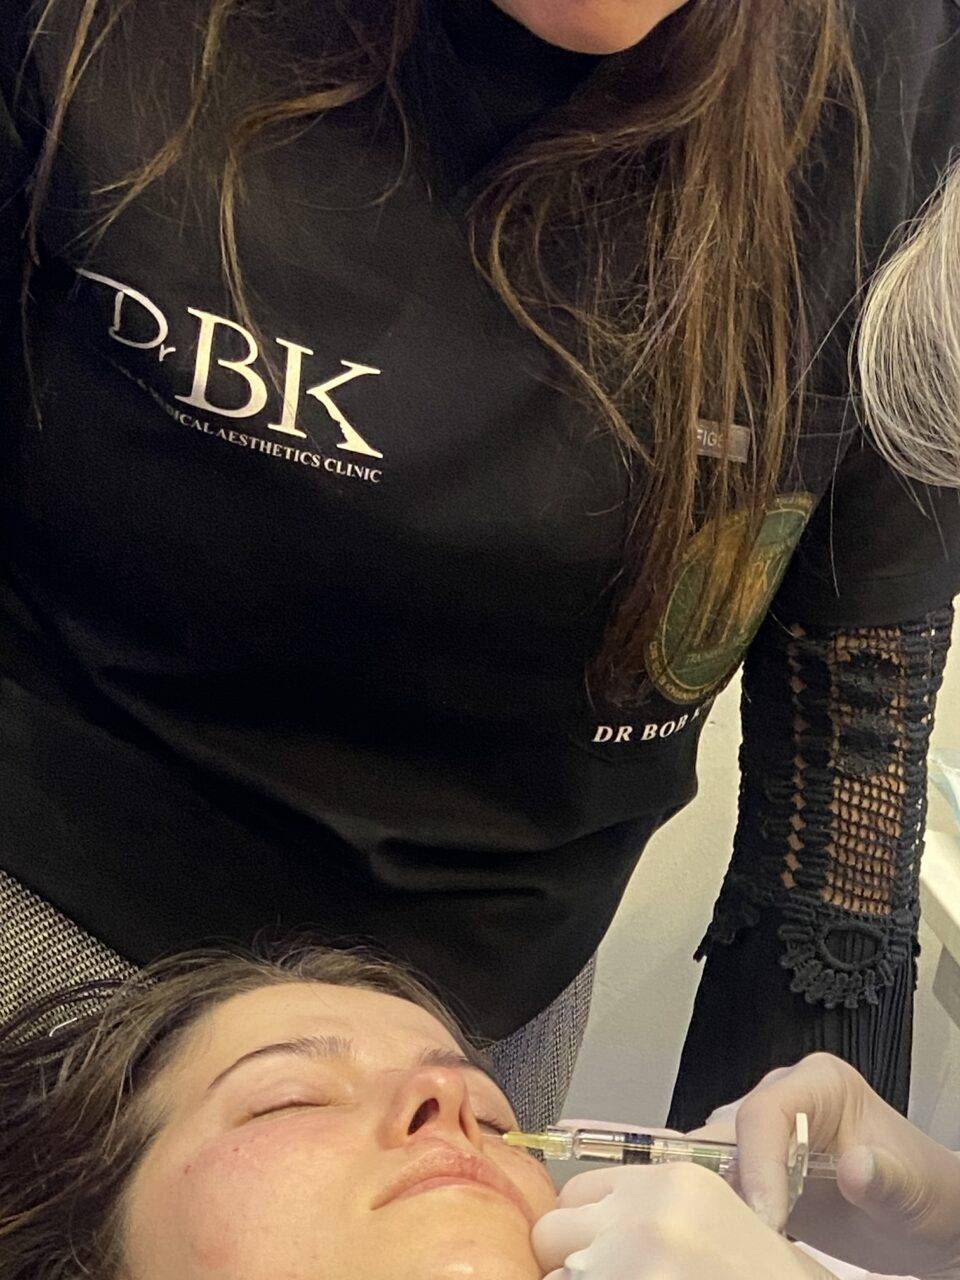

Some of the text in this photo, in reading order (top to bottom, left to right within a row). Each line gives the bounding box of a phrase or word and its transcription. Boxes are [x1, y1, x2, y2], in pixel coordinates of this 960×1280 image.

[75, 267, 384, 459] Dr BK
[214, 427, 322, 468] AESTHETICS
[323, 457, 383, 483] CLINIC
[591, 724, 634, 743] DR
